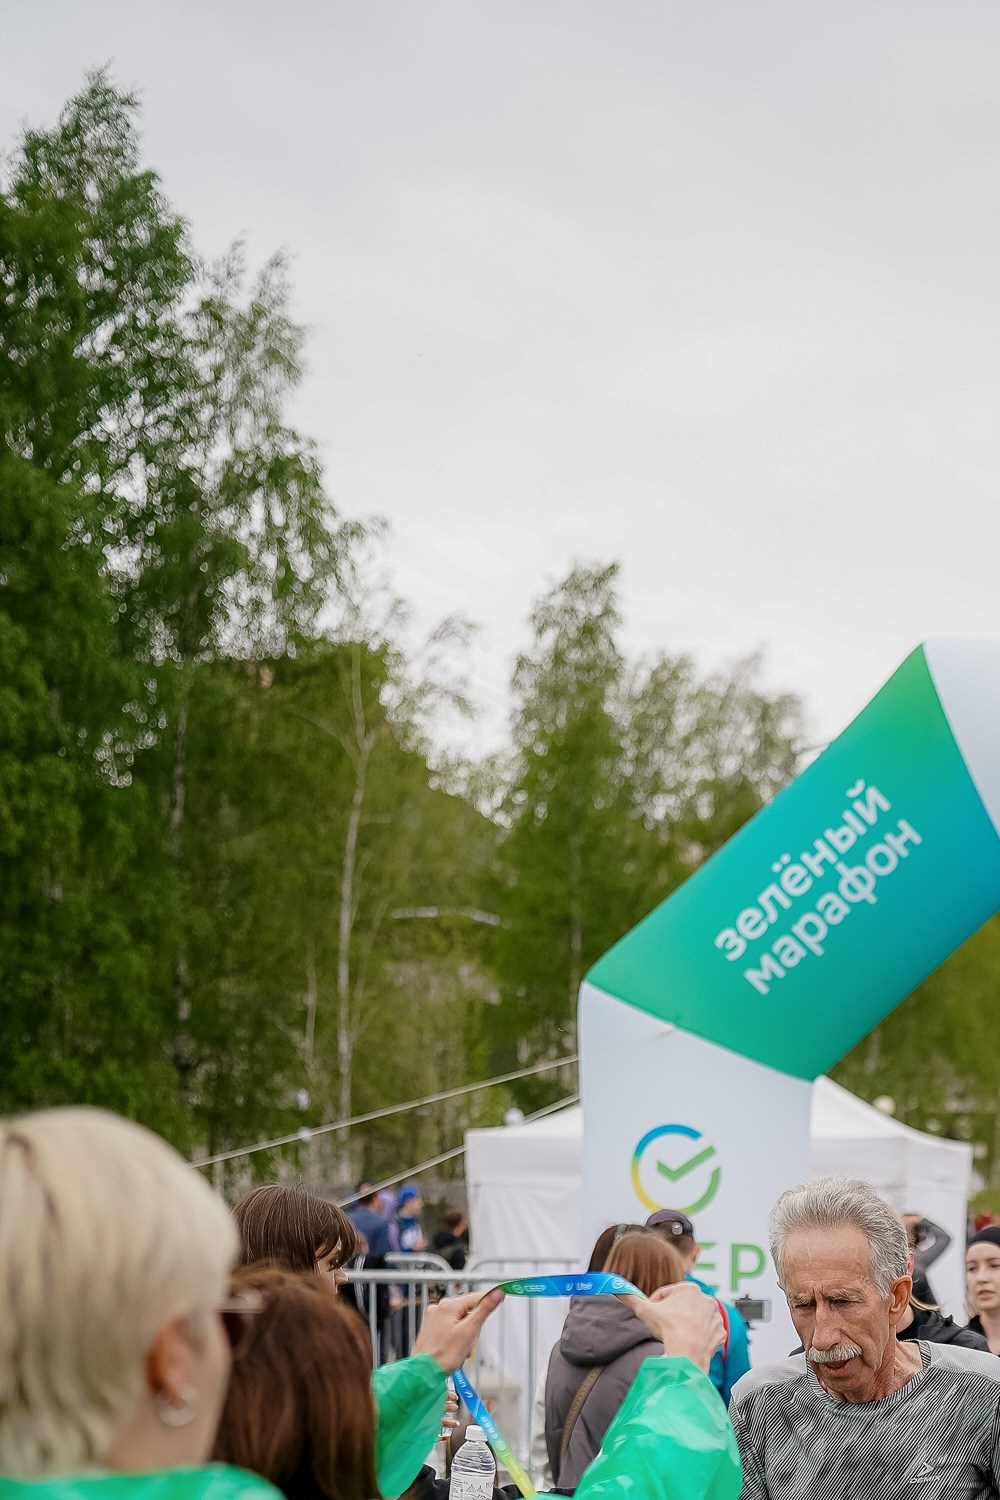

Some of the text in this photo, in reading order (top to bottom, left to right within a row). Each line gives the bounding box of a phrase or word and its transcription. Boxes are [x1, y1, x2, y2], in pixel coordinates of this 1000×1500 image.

[714, 779, 892, 961] зелёный
[743, 818, 923, 995] марафон
[694, 1242, 766, 1293] ЕР
